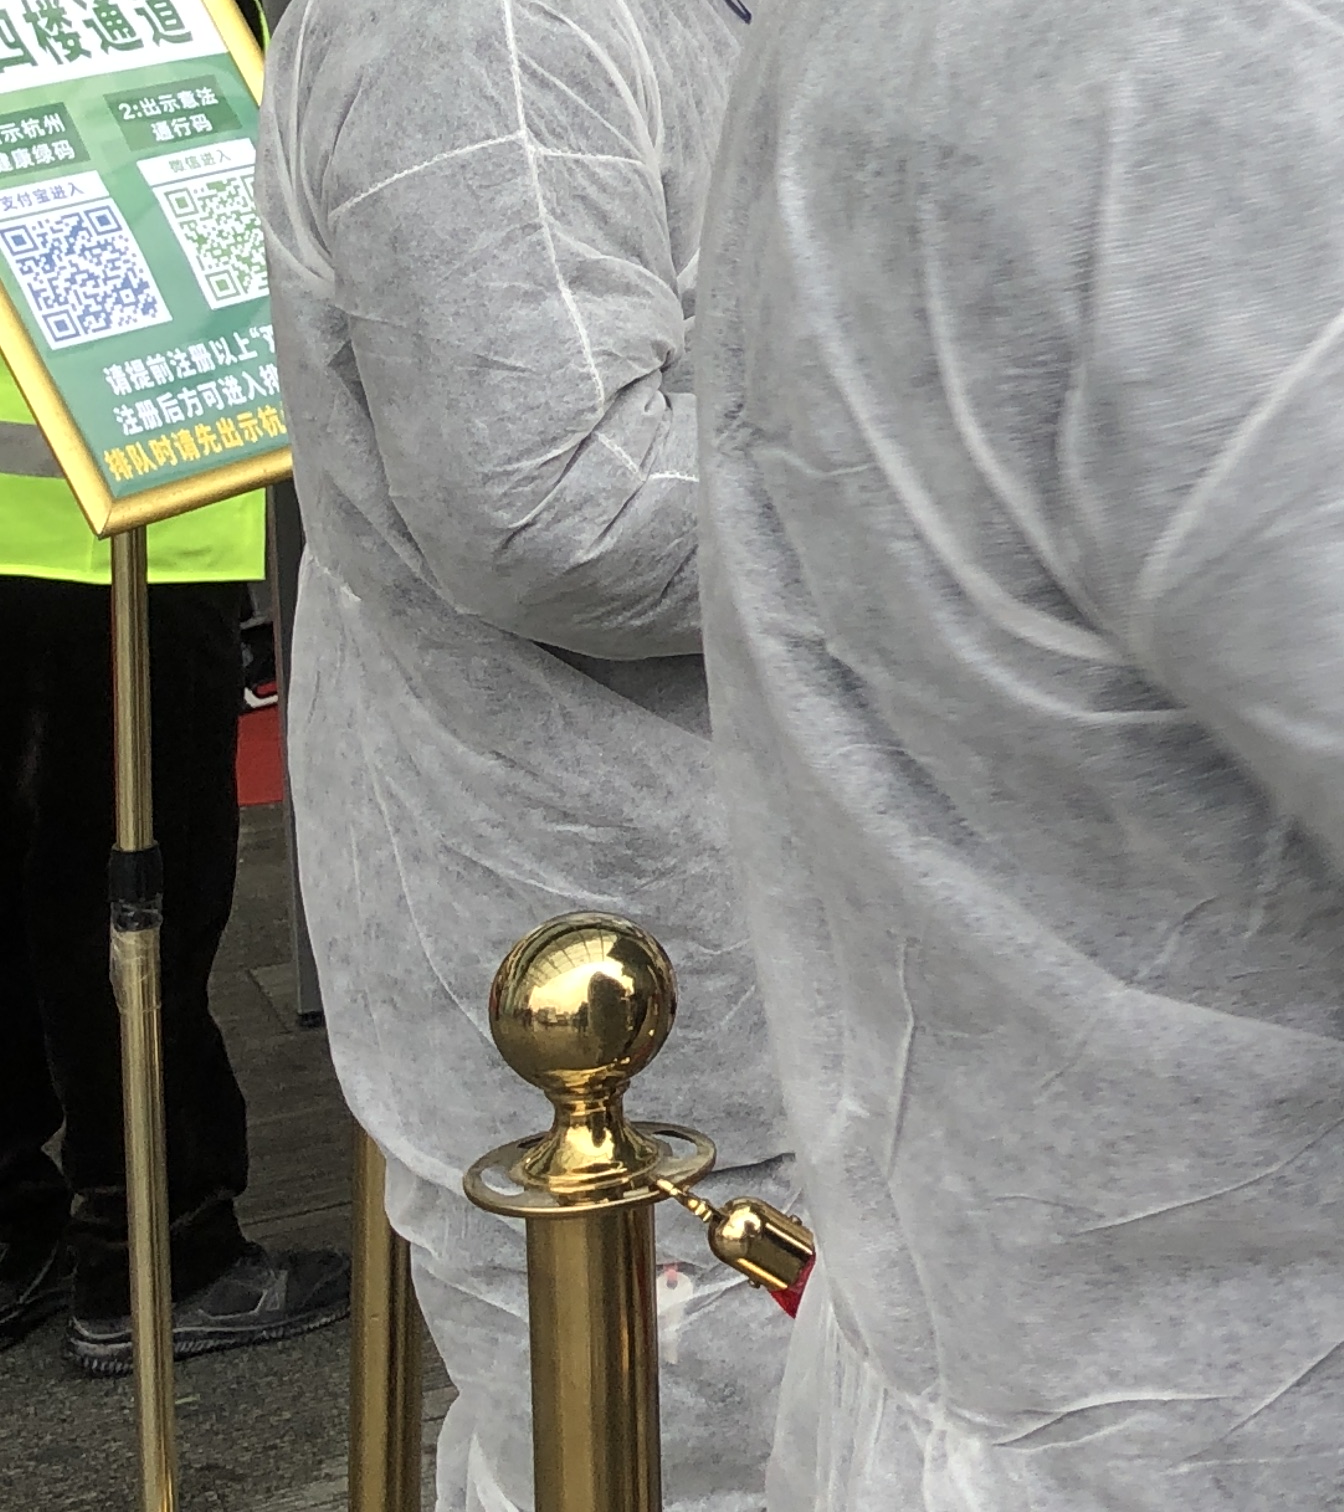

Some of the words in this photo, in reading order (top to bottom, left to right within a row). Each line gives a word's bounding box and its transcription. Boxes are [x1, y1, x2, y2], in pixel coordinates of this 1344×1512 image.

[0, 112, 66, 145] 示杭州
[151, 113, 214, 143] 通行码
[103, 400, 287, 482] 排队时请先出示杭
